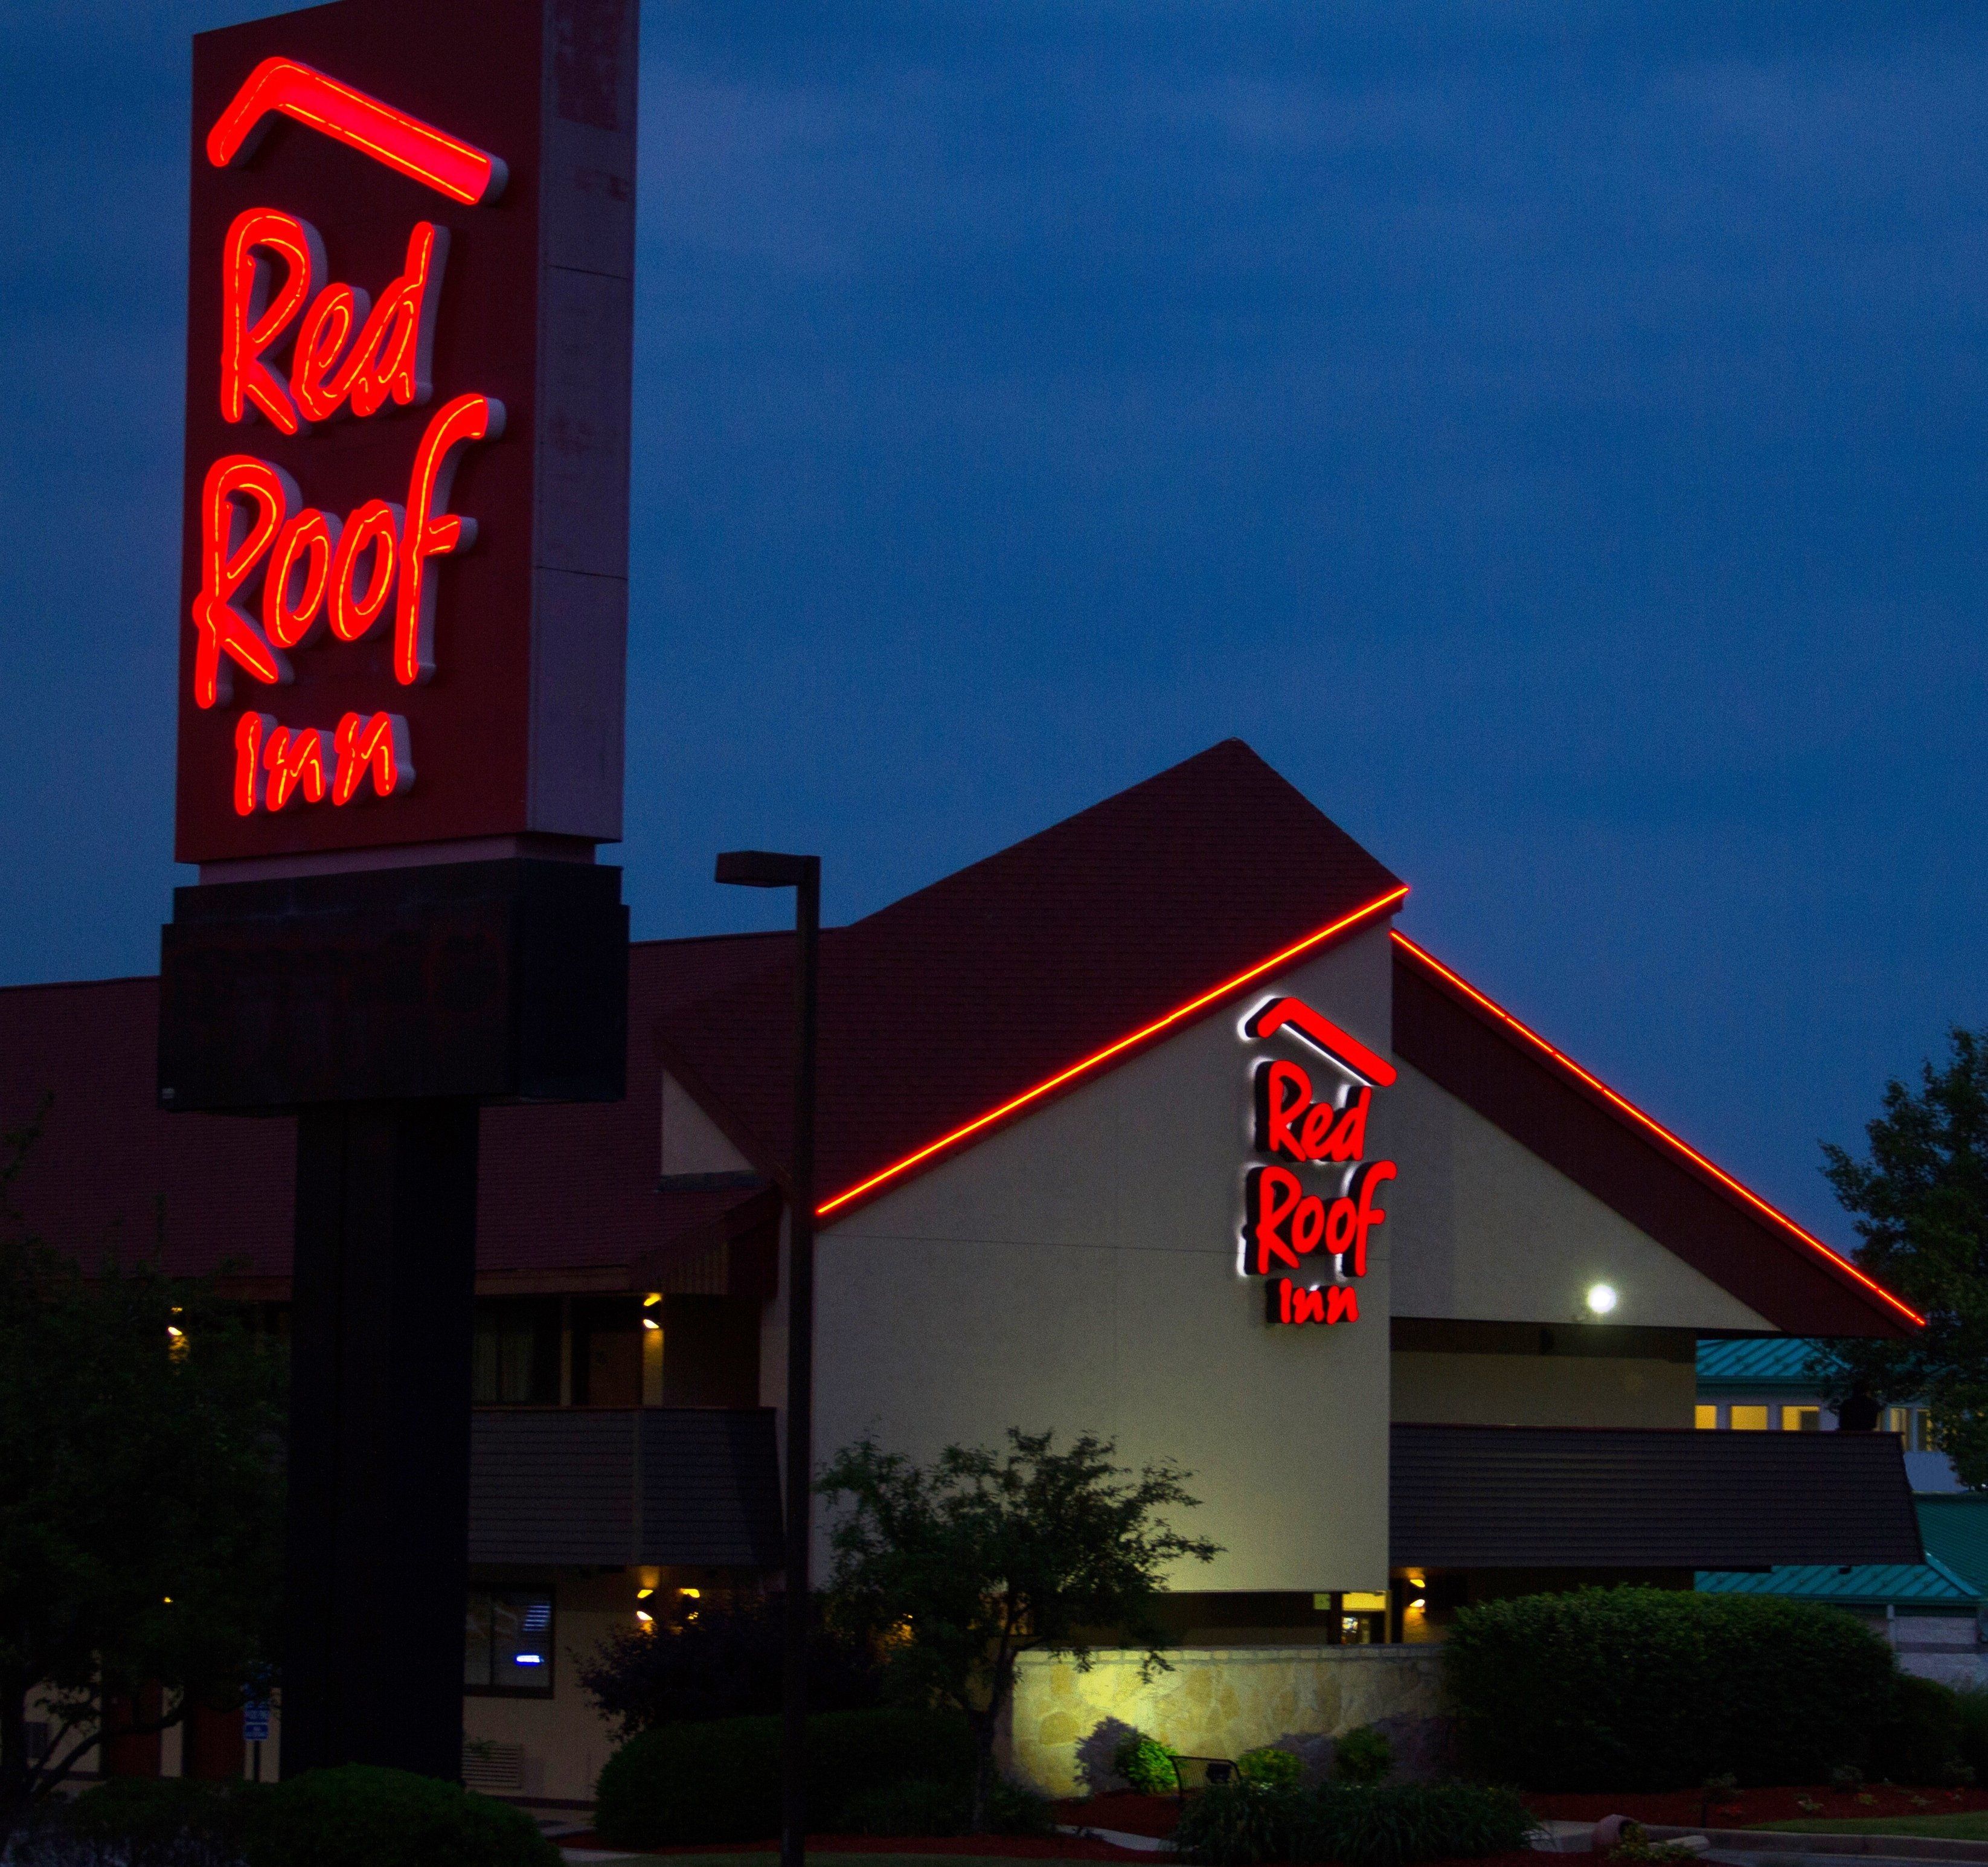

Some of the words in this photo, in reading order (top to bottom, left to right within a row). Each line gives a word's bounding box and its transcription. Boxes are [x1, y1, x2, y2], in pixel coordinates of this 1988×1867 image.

[222, 208, 436, 434] Red
[193, 394, 488, 708] Roof
[236, 712, 397, 815] Inn
[1270, 1060, 1372, 1162] Red
[1256, 1160, 1397, 1276] Roof
[1279, 1278, 1359, 1324] Inn
